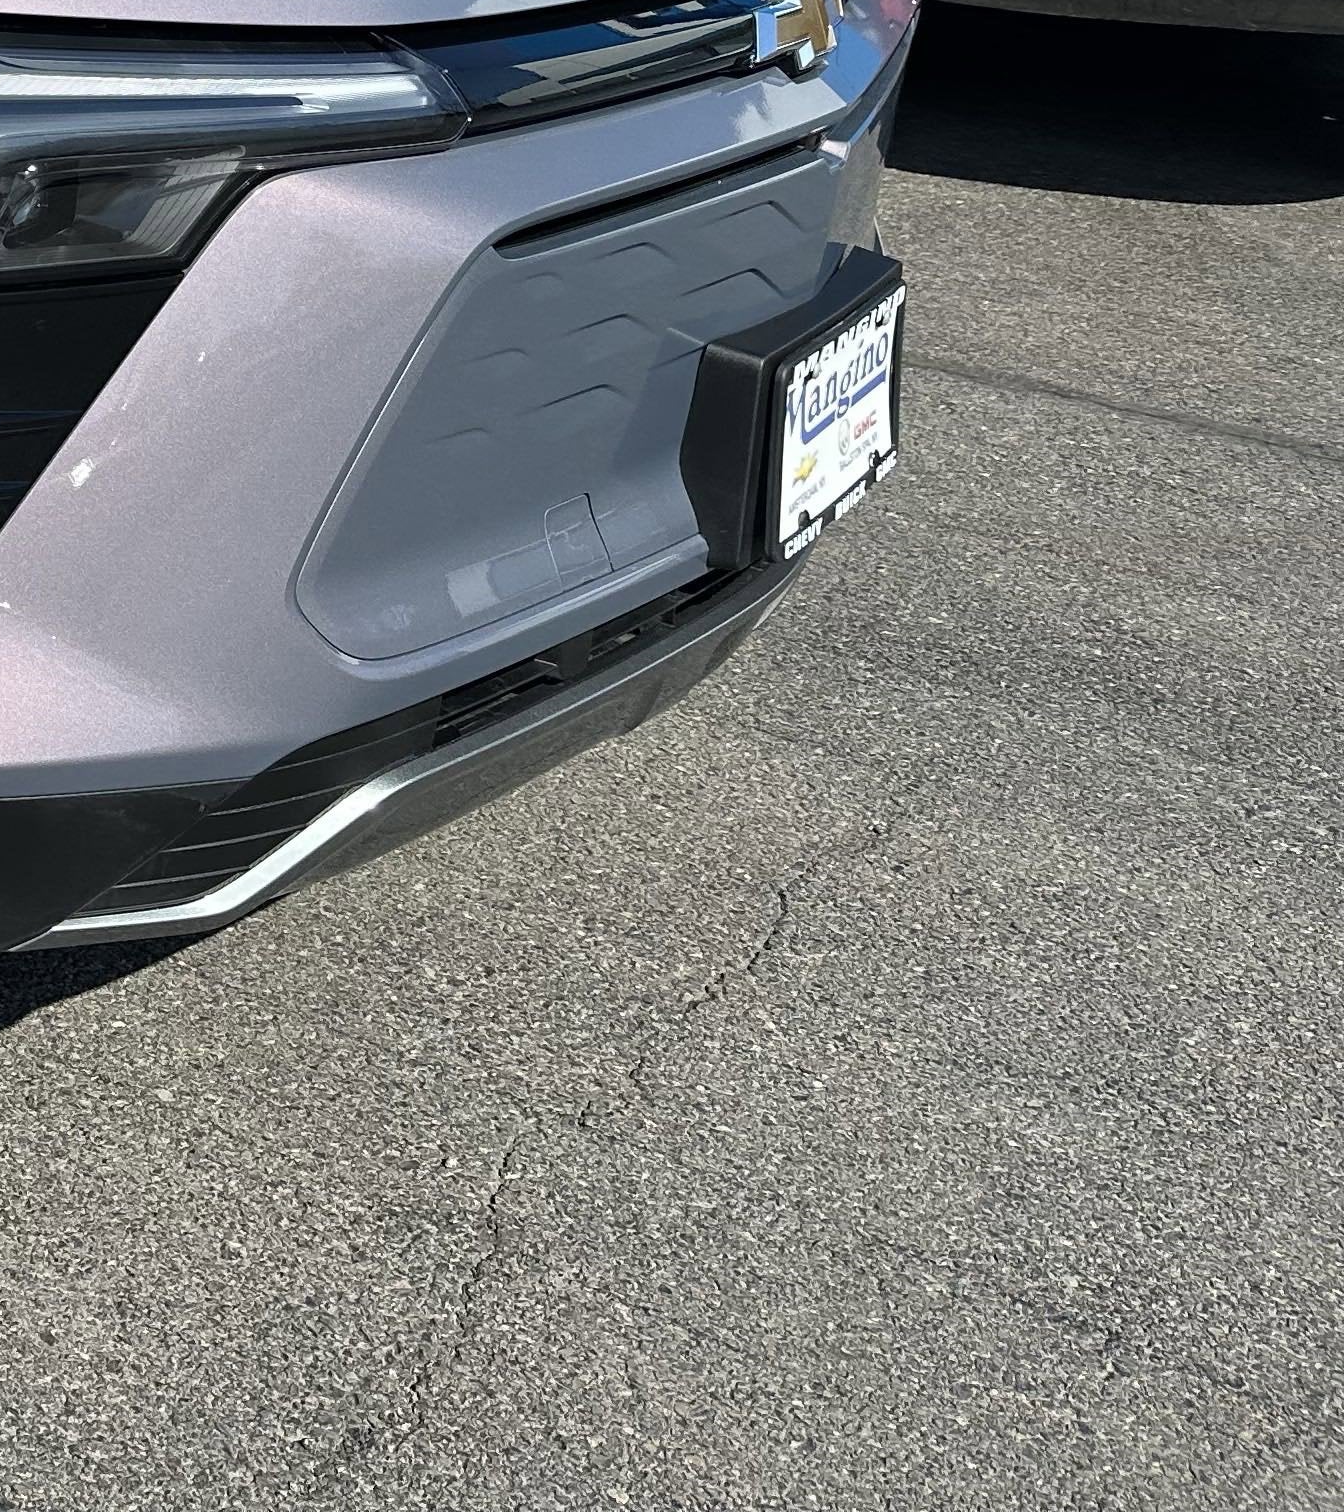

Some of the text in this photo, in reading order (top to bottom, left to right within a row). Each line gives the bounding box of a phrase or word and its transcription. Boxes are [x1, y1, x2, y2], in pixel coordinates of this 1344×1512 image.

[853, 409, 877, 440] GMC
[784, 517, 823, 560] CHEVY
[835, 480, 866, 521] BUICK
[875, 450, 897, 482] GMC
